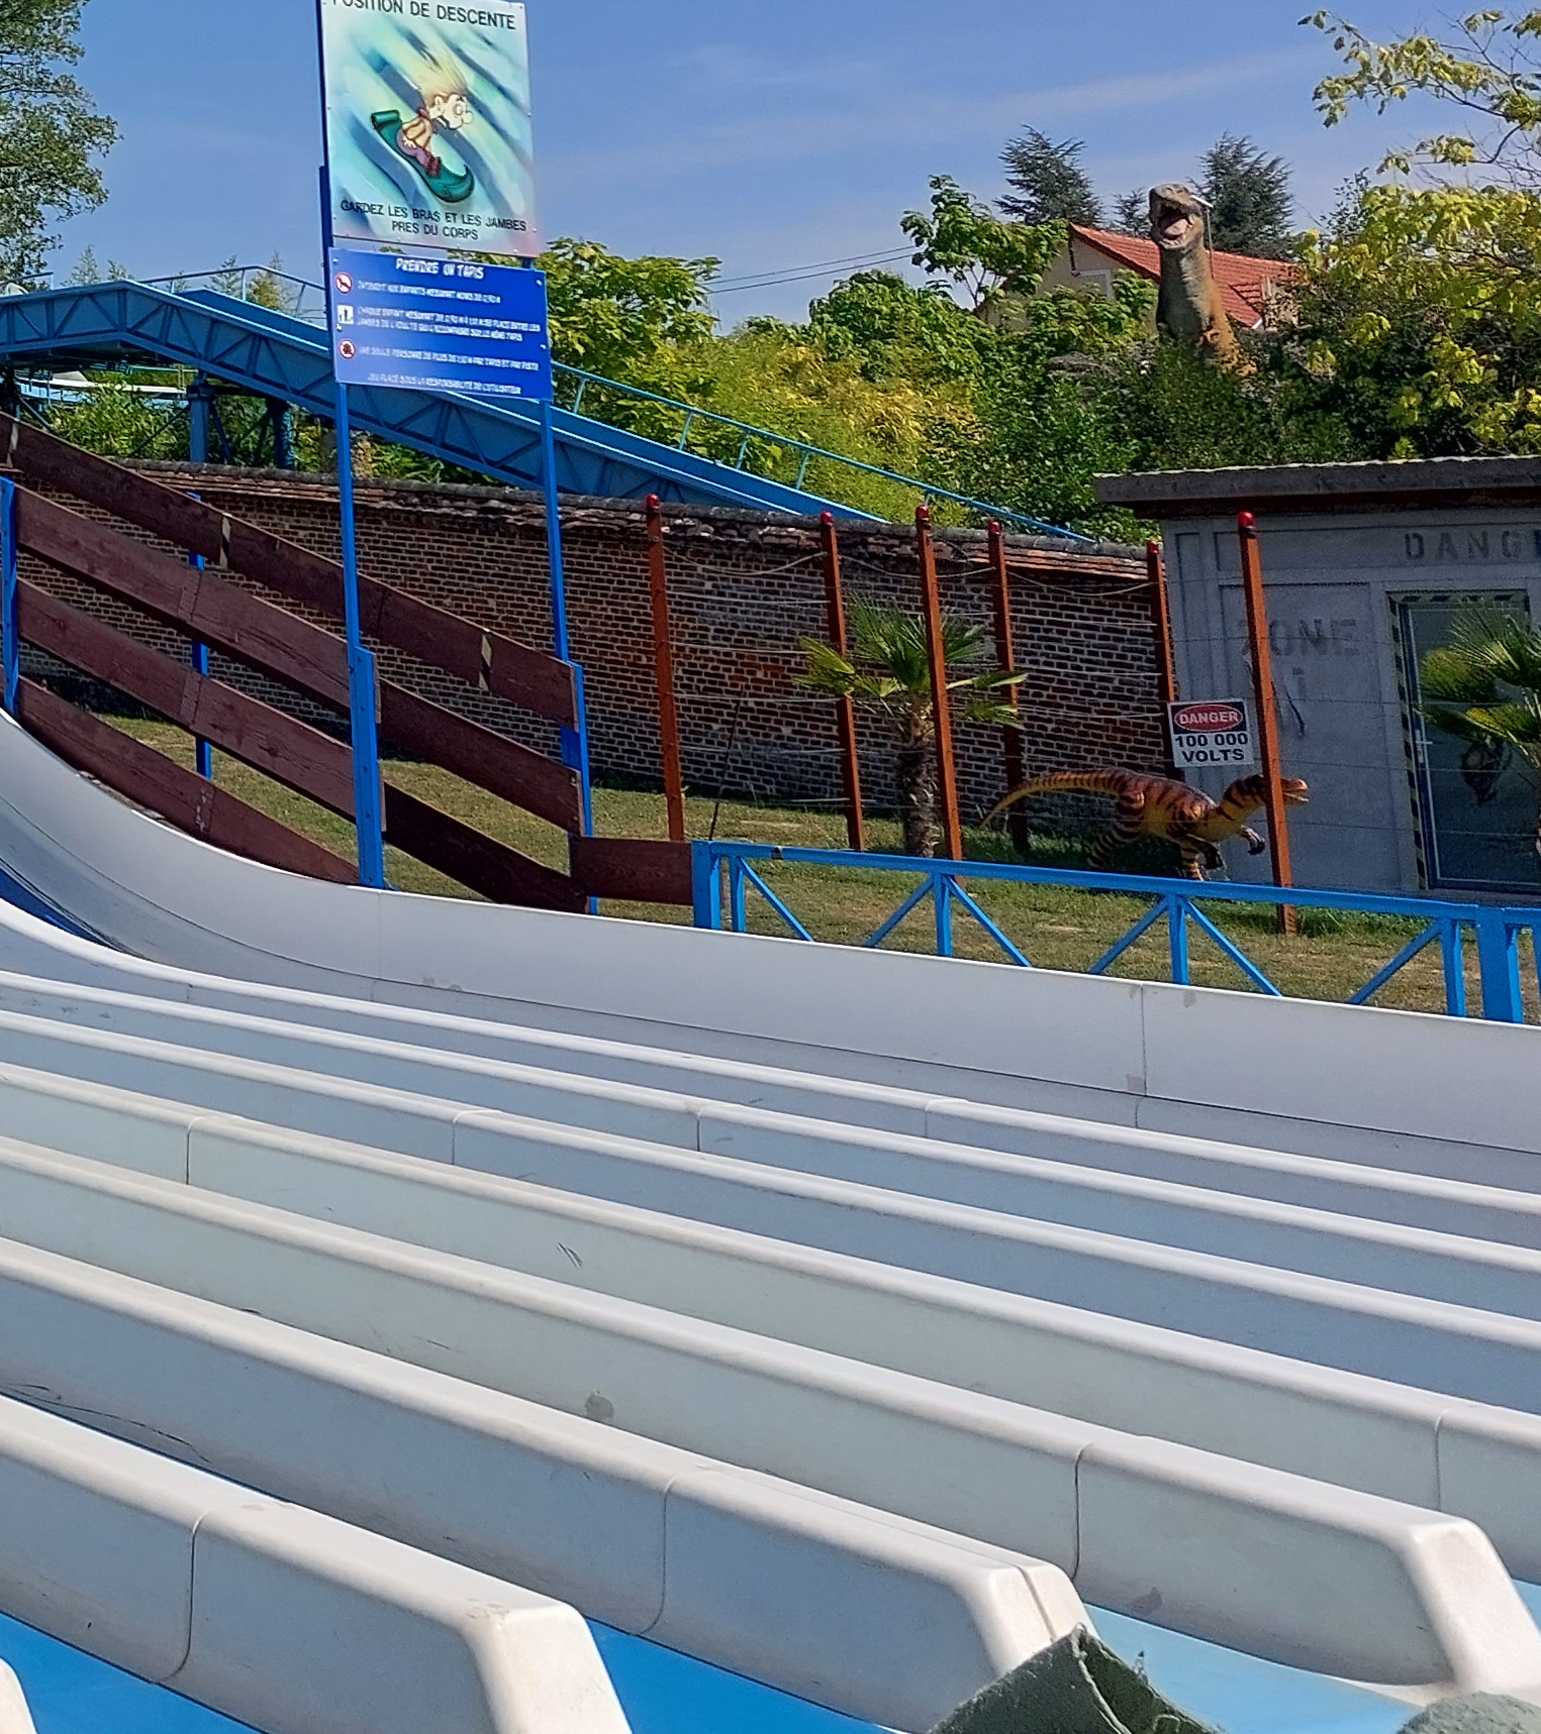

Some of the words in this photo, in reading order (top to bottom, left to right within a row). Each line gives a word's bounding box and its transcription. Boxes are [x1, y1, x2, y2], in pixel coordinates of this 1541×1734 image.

[410, 0, 430, 18] DE
[436, 4, 516, 30] DESCENTE
[340, 199, 384, 215] GARDEZ
[387, 204, 408, 219] LES
[411, 207, 441, 223] BRAS
[445, 212, 460, 224] ET
[461, 214, 481, 227] LES
[485, 216, 527, 232] JAMBES
[391, 220, 419, 234] PRES
[423, 223, 438, 236] DU
[442, 225, 478, 241] CORPS
[1179, 711, 1239, 724] DANGER
[1175, 734, 1208, 748] 100
[1214, 732, 1248, 746] 000
[1181, 748, 1244, 762] VOLTS
